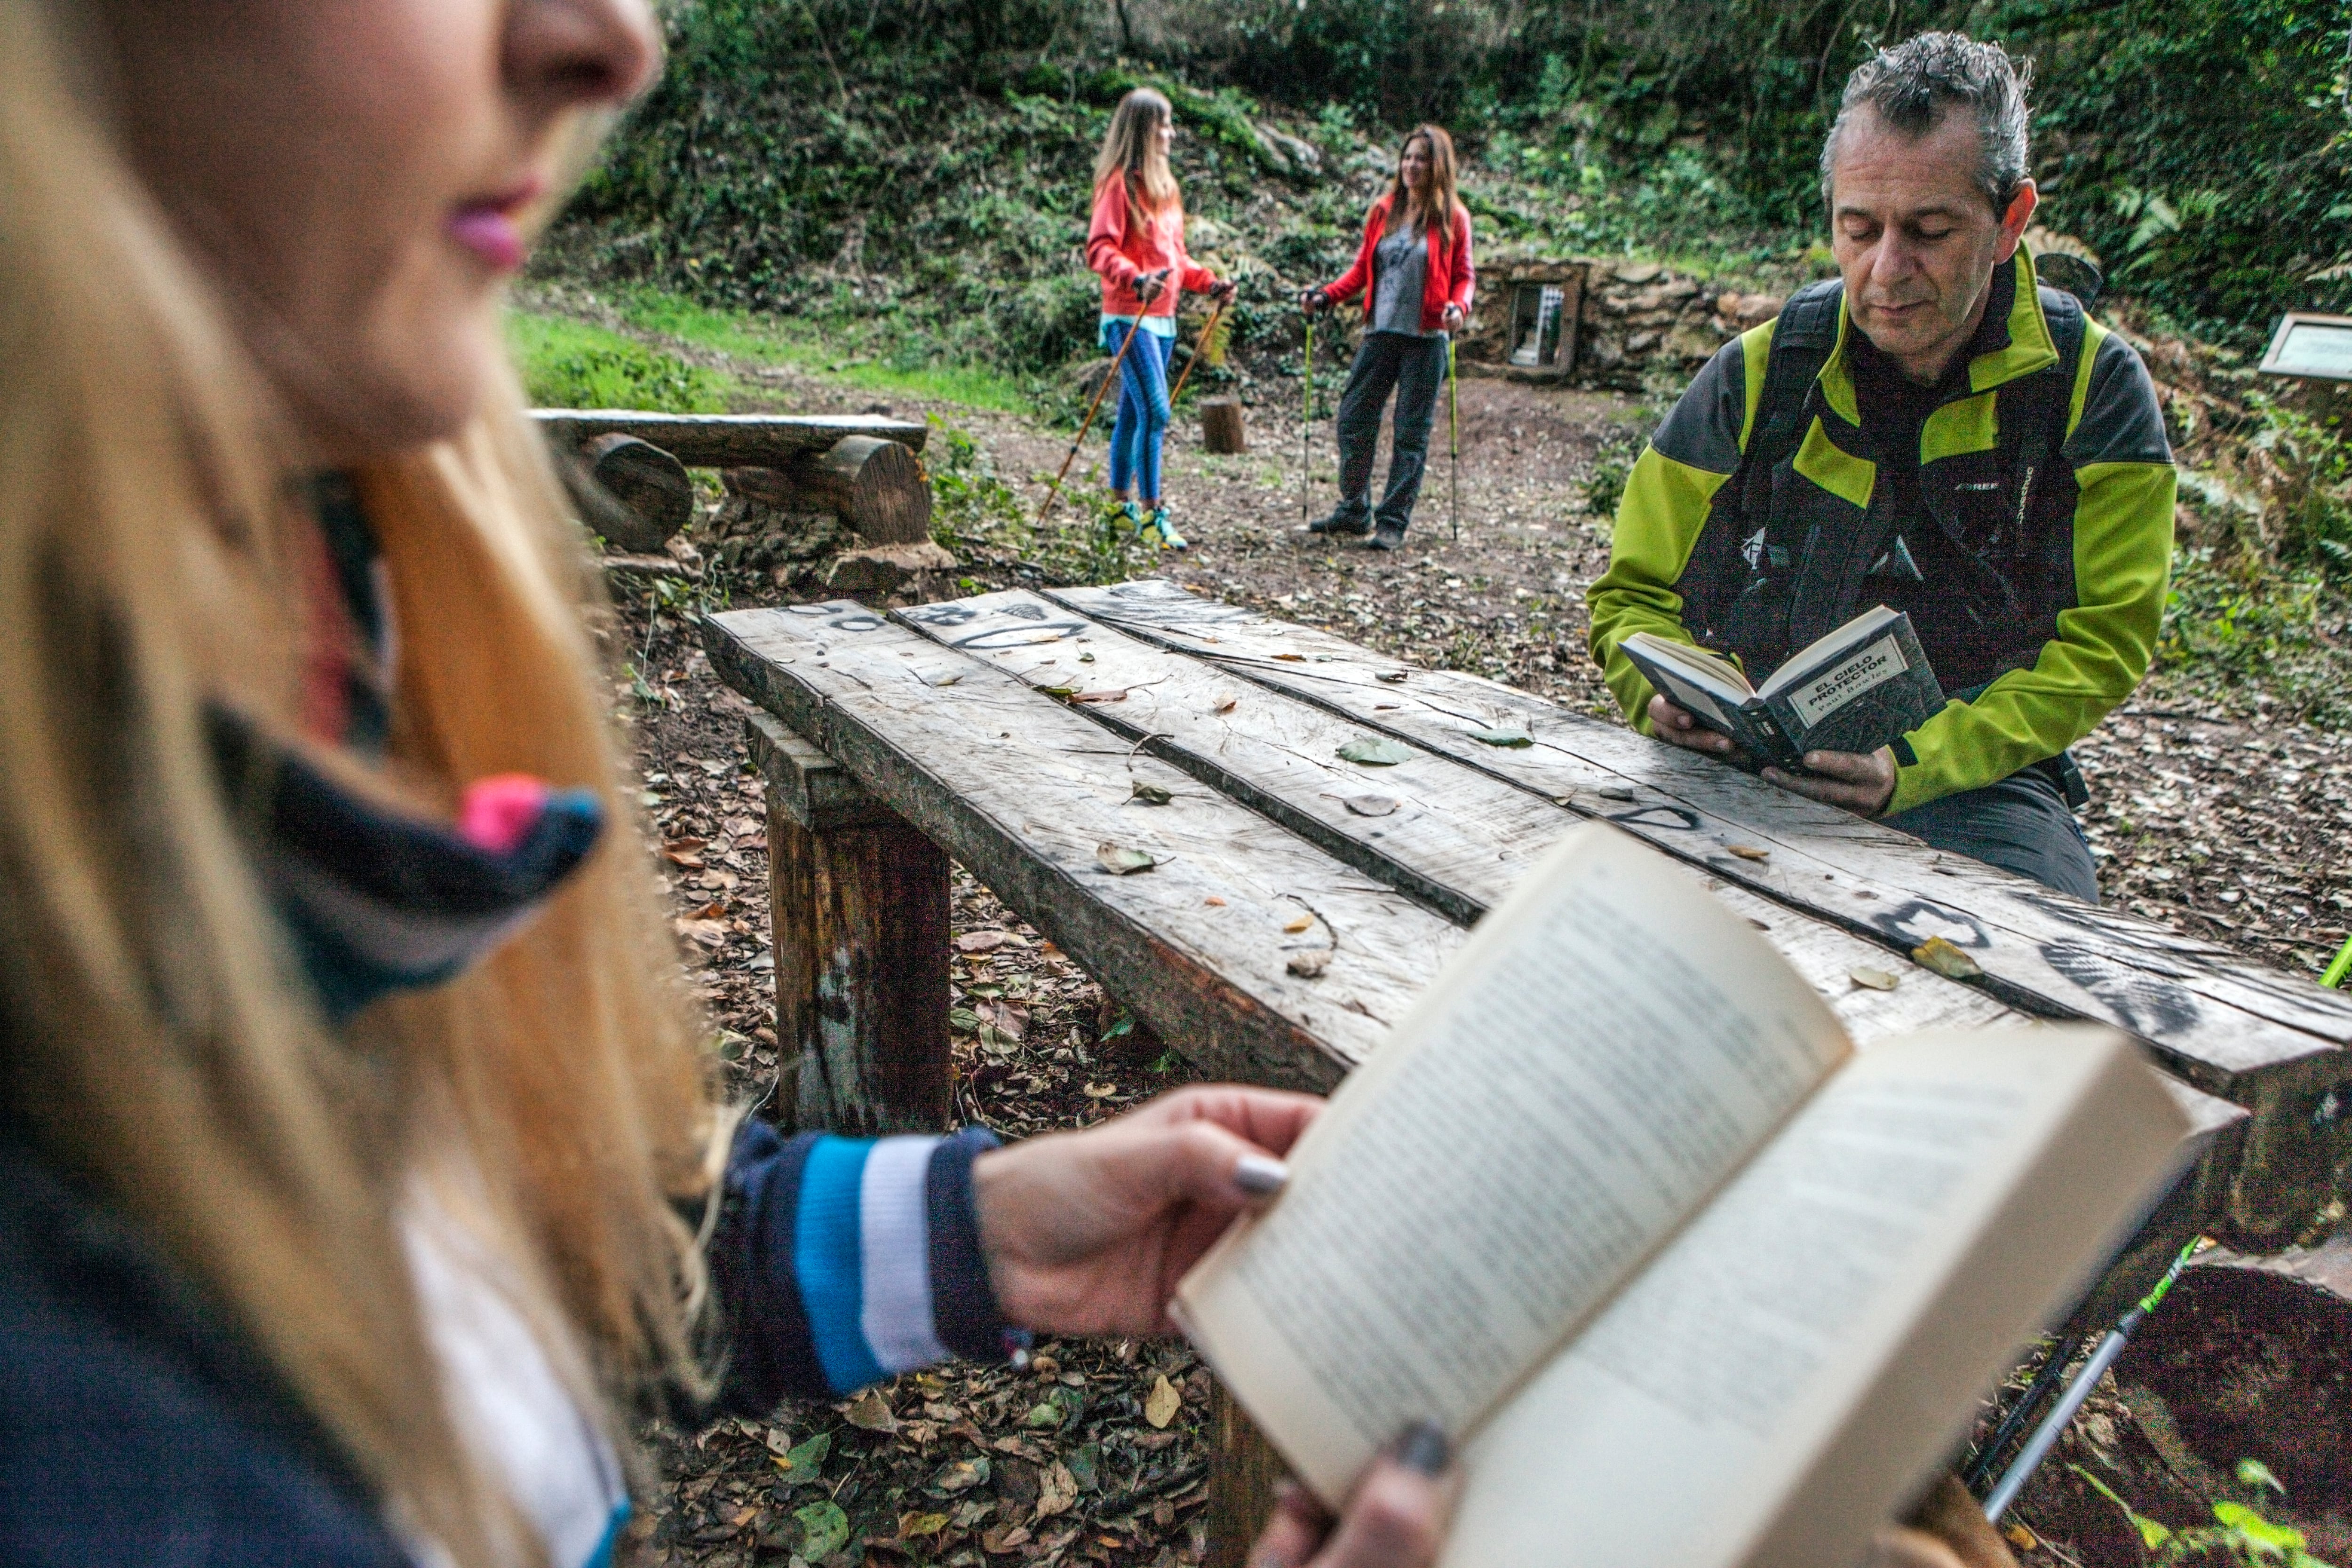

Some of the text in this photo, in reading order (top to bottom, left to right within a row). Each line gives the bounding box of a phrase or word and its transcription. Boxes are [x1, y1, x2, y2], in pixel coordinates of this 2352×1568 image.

[1808, 655, 1887, 706] PROTECTOR
[1815, 655, 1872, 693] EL CIELO
[1819, 669, 1888, 712] Paul Bowles
